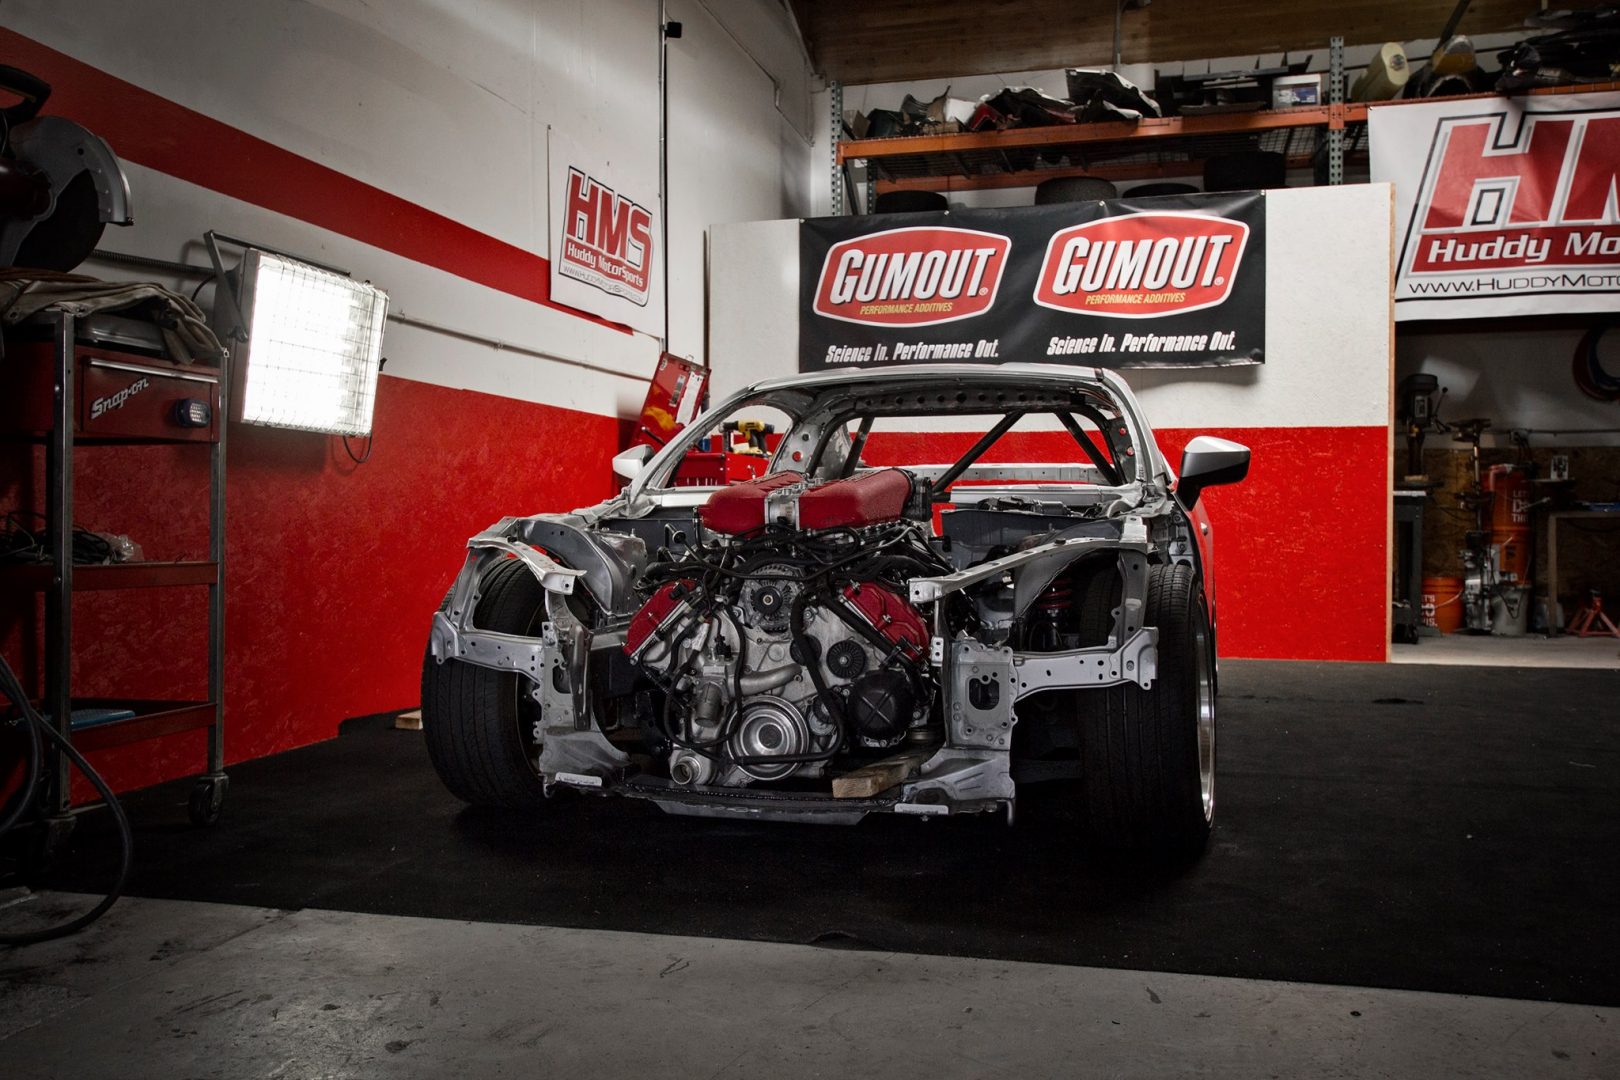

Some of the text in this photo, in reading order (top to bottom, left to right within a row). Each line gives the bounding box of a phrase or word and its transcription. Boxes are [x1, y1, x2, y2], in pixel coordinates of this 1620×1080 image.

[566, 172, 653, 265] HMS
[567, 242, 597, 269] Huddy
[1427, 234, 1552, 264] Huddy
[830, 249, 996, 304] GUMOUT
[1052, 235, 1231, 295] GUMOUT
[1409, 274, 1620, 294] WWW.HUDDYMOT
[860, 302, 953, 315] PERFORMANCE ADDITIVES
[1085, 292, 1186, 305] PERFORMANCE ADDITIVES
[825, 339, 999, 364] Science In. Performance Out.
[1046, 330, 1236, 355] Science In. Performance Out.
[91, 377, 150, 420] Snap-on
